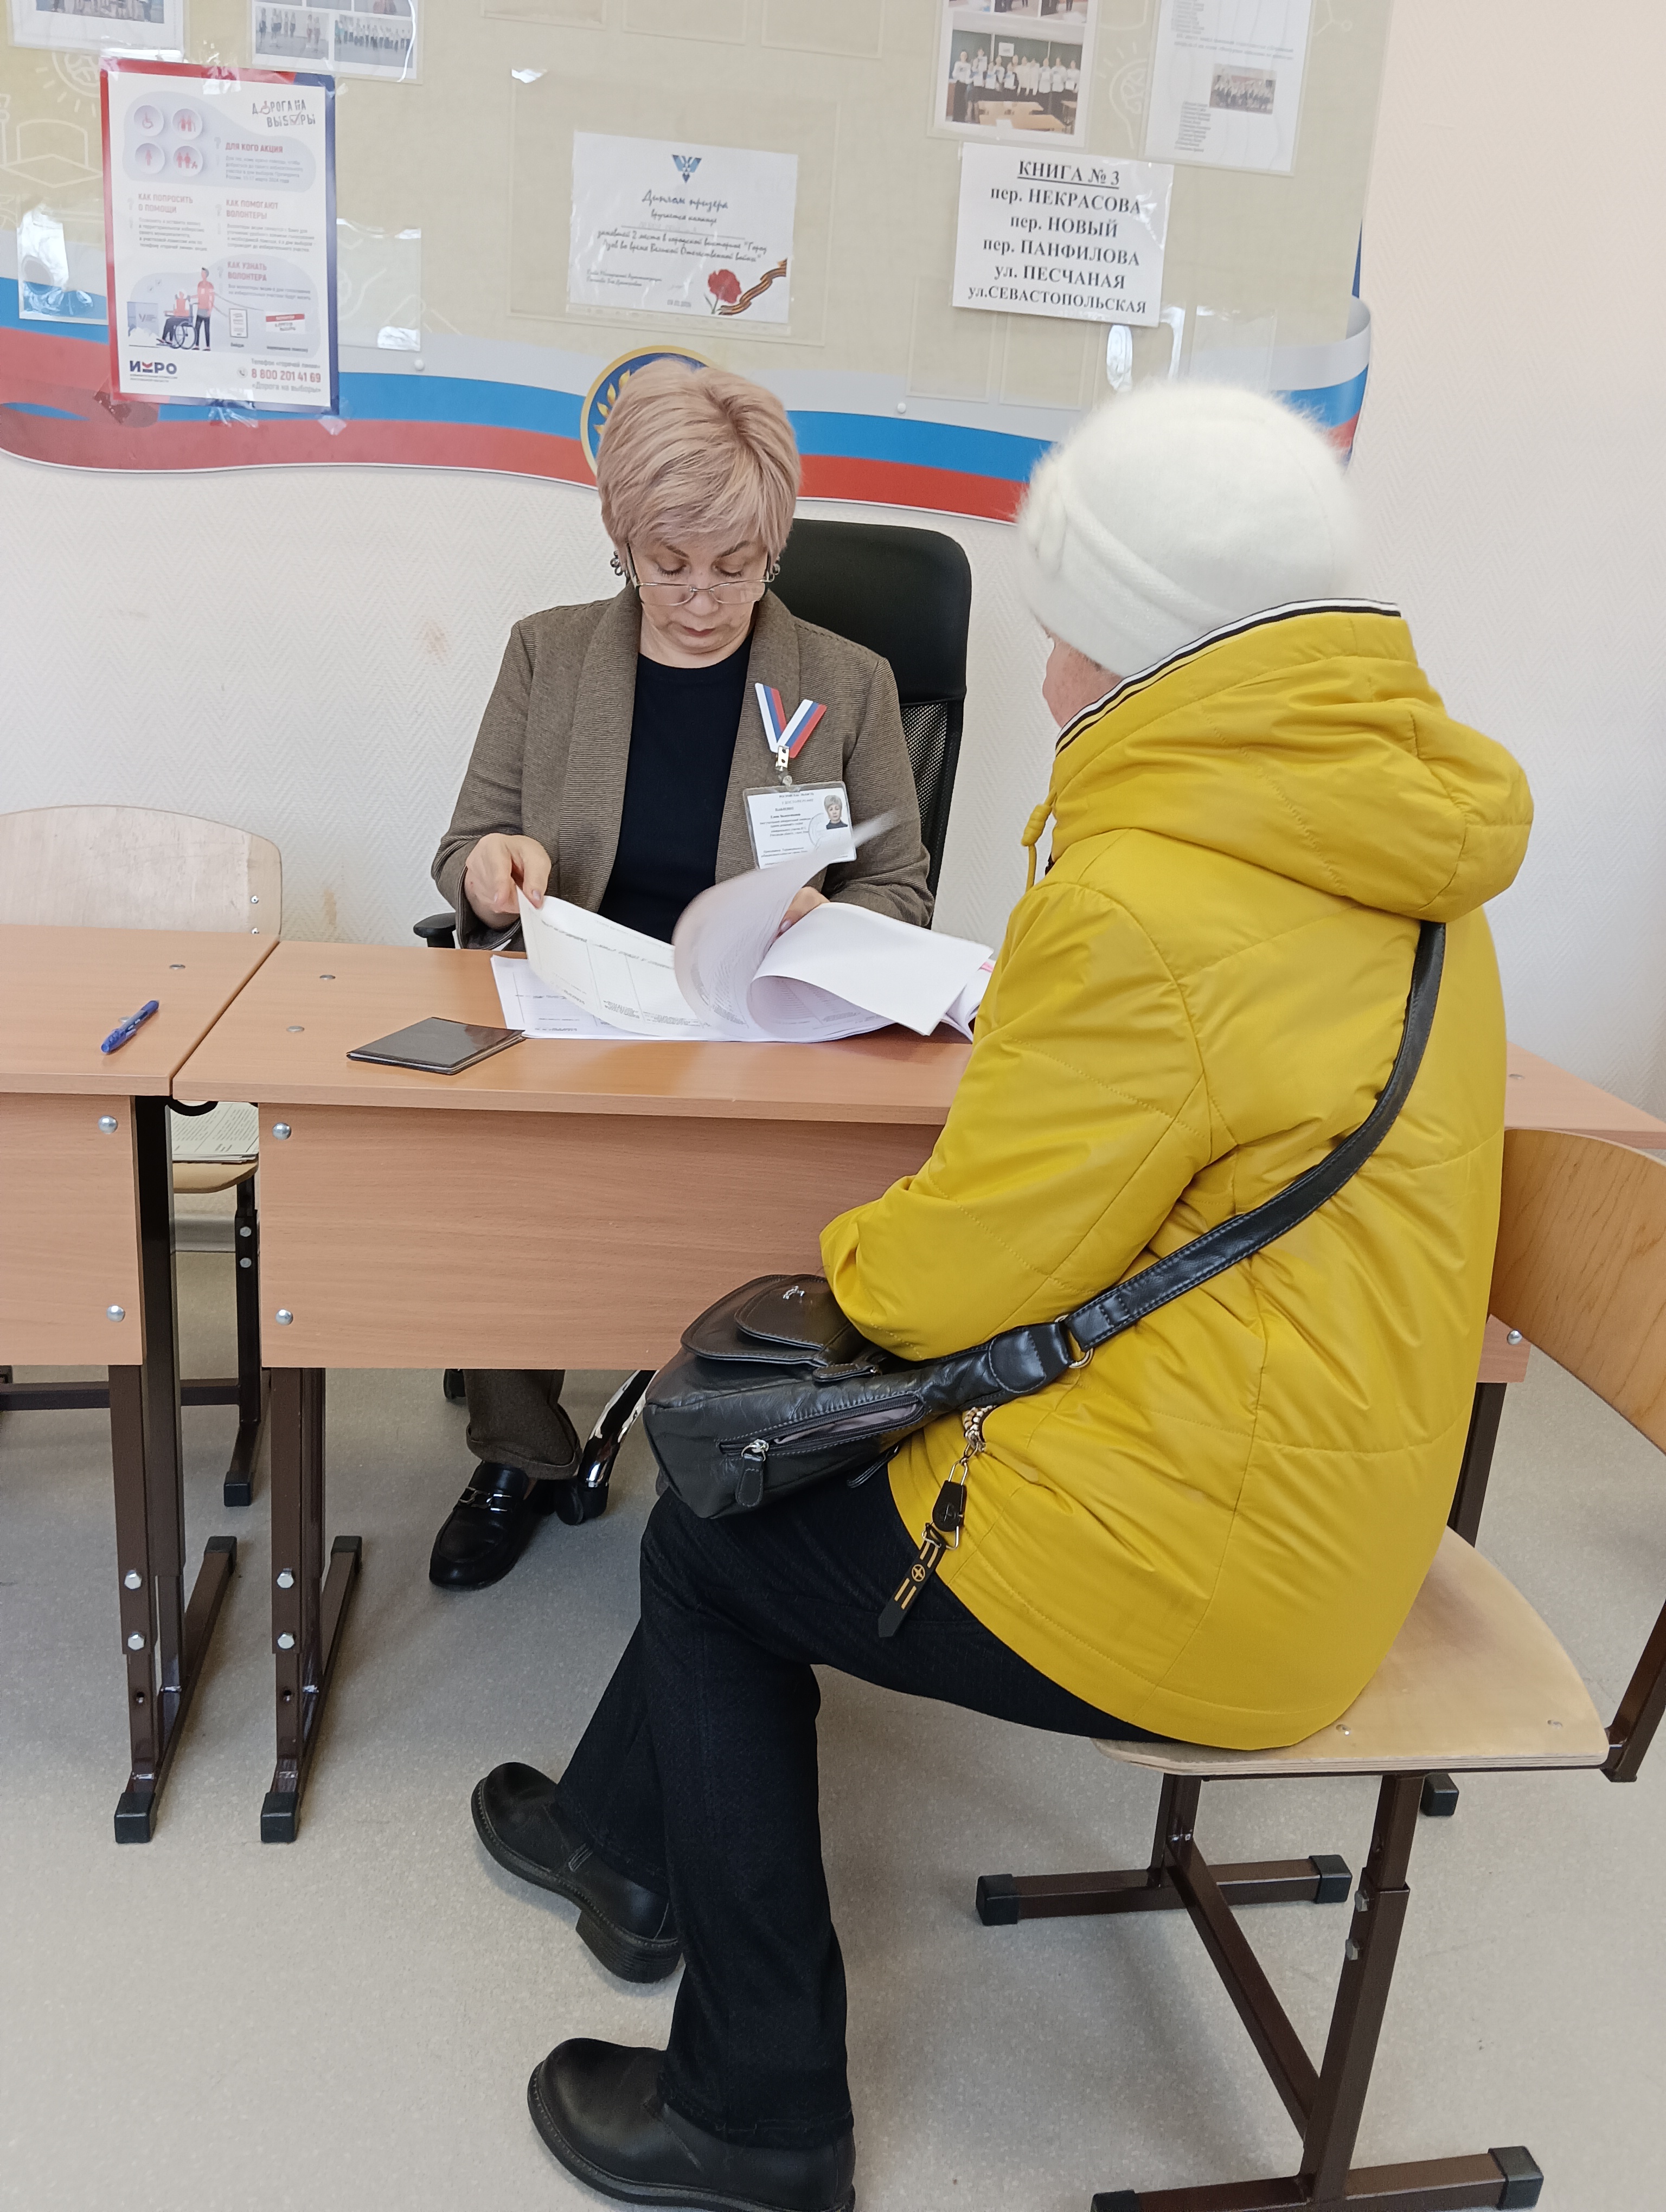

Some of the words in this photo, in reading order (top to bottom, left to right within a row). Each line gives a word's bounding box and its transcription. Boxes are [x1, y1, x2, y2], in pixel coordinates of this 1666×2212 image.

[241, 143, 259, 151] КОГО
[260, 145, 283, 153] АКЦИЯ
[1018, 160, 1083, 182] КНИГА
[1087, 168, 1106, 184] №
[1111, 170, 1120, 185] 3
[153, 194, 193, 204] ПОПРОСИТЬ
[226, 199, 239, 207] КАК
[240, 200, 278, 210] ПОМОГАЮТ
[990, 188, 1022, 204] пер.
[1028, 188, 1140, 215] НЕКРАСОВА
[145, 204, 177, 214] ПОМОЩИ
[226, 210, 267, 220] ВОЛОНТЕРЫ
[1010, 216, 1042, 232] пер.
[1048, 216, 1118, 237] НОВЫЙ
[983, 239, 1015, 255] пер.
[1021, 240, 1140, 266] ПАНФИЛОВА
[242, 262, 267, 271] УЗНАТЬ
[228, 272, 267, 281] ВОЛОНТЕРА
[994, 265, 1017, 280] ул.
[1023, 265, 1125, 290] ПЕСЧАНАЯ
[968, 285, 1146, 314] ул.СЕВАСТОПОЛЬСКАЯ
[252, 368, 257, 378] 8
[260, 369, 278, 380] 800
[280, 370, 295, 381] 201
[297, 371, 307, 382] 41
[310, 372, 321, 383] 69
